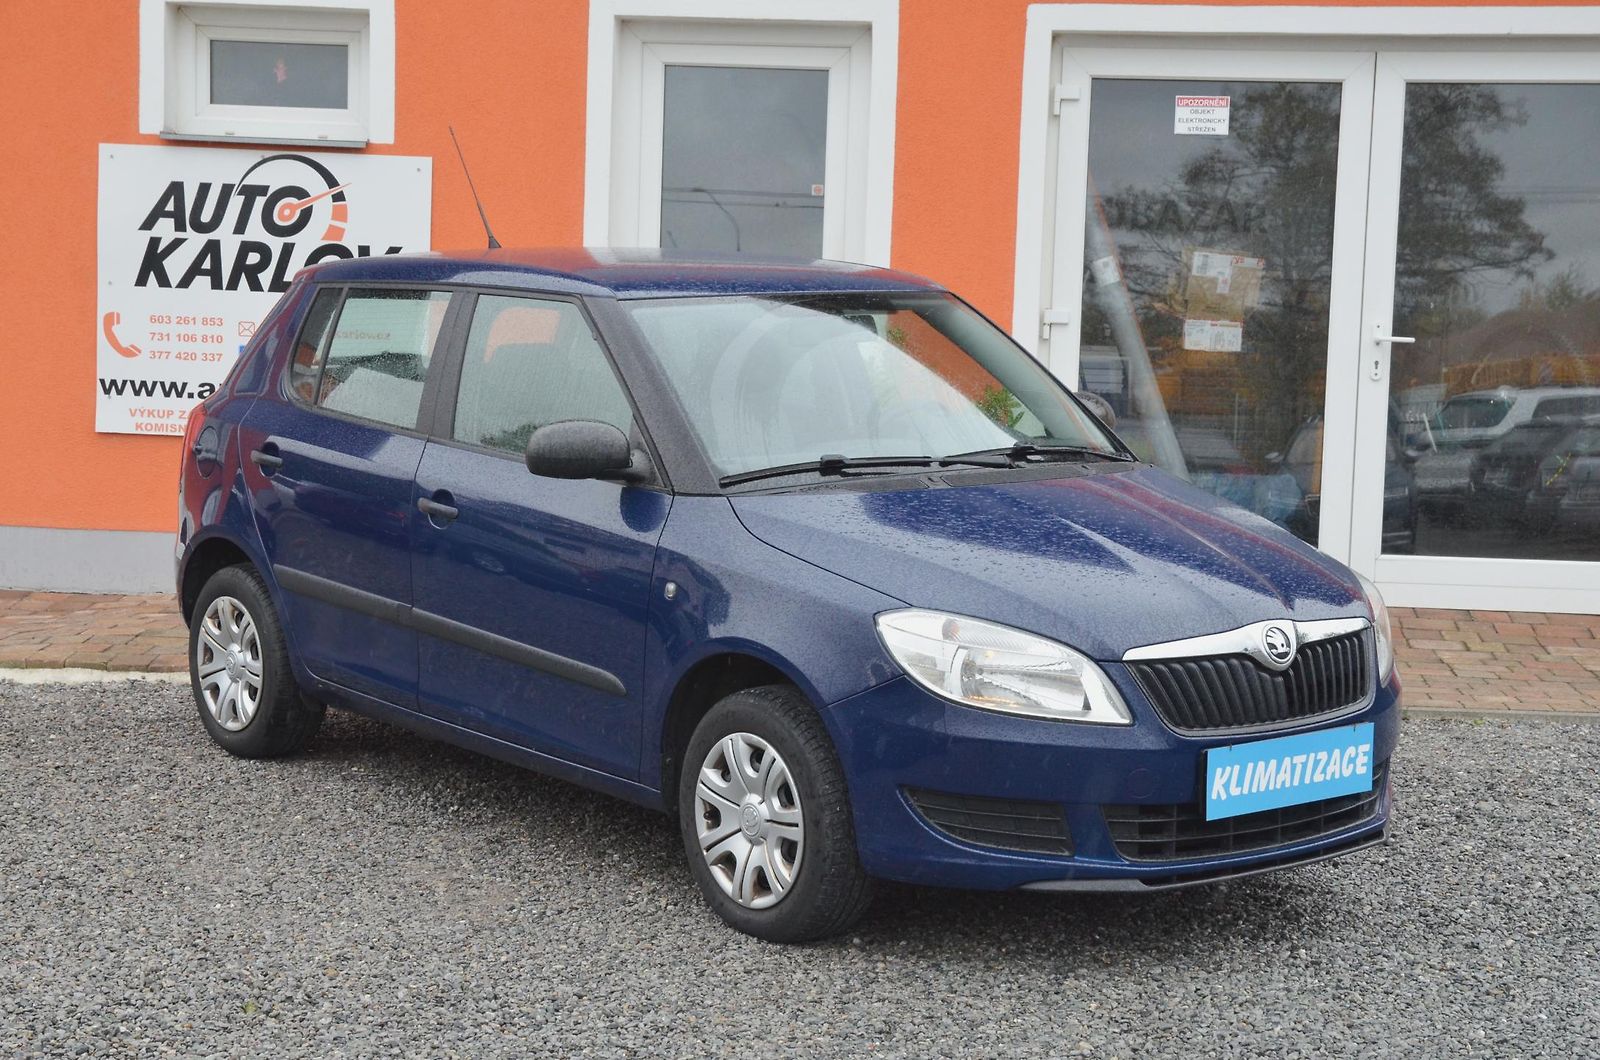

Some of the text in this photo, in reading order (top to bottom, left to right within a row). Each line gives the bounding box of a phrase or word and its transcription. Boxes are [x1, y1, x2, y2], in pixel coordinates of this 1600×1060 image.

[138, 181, 313, 238] AUTO
[134, 237, 403, 293] KARL
[149, 314, 224, 327] 603 261 853
[149, 332, 224, 344] 731 106 810
[149, 350, 224, 362] 377 420 337
[99, 378, 222, 400] www.a
[128, 407, 174, 420] VÝKUP
[1211, 743, 1371, 801] KLIMATIZACE
